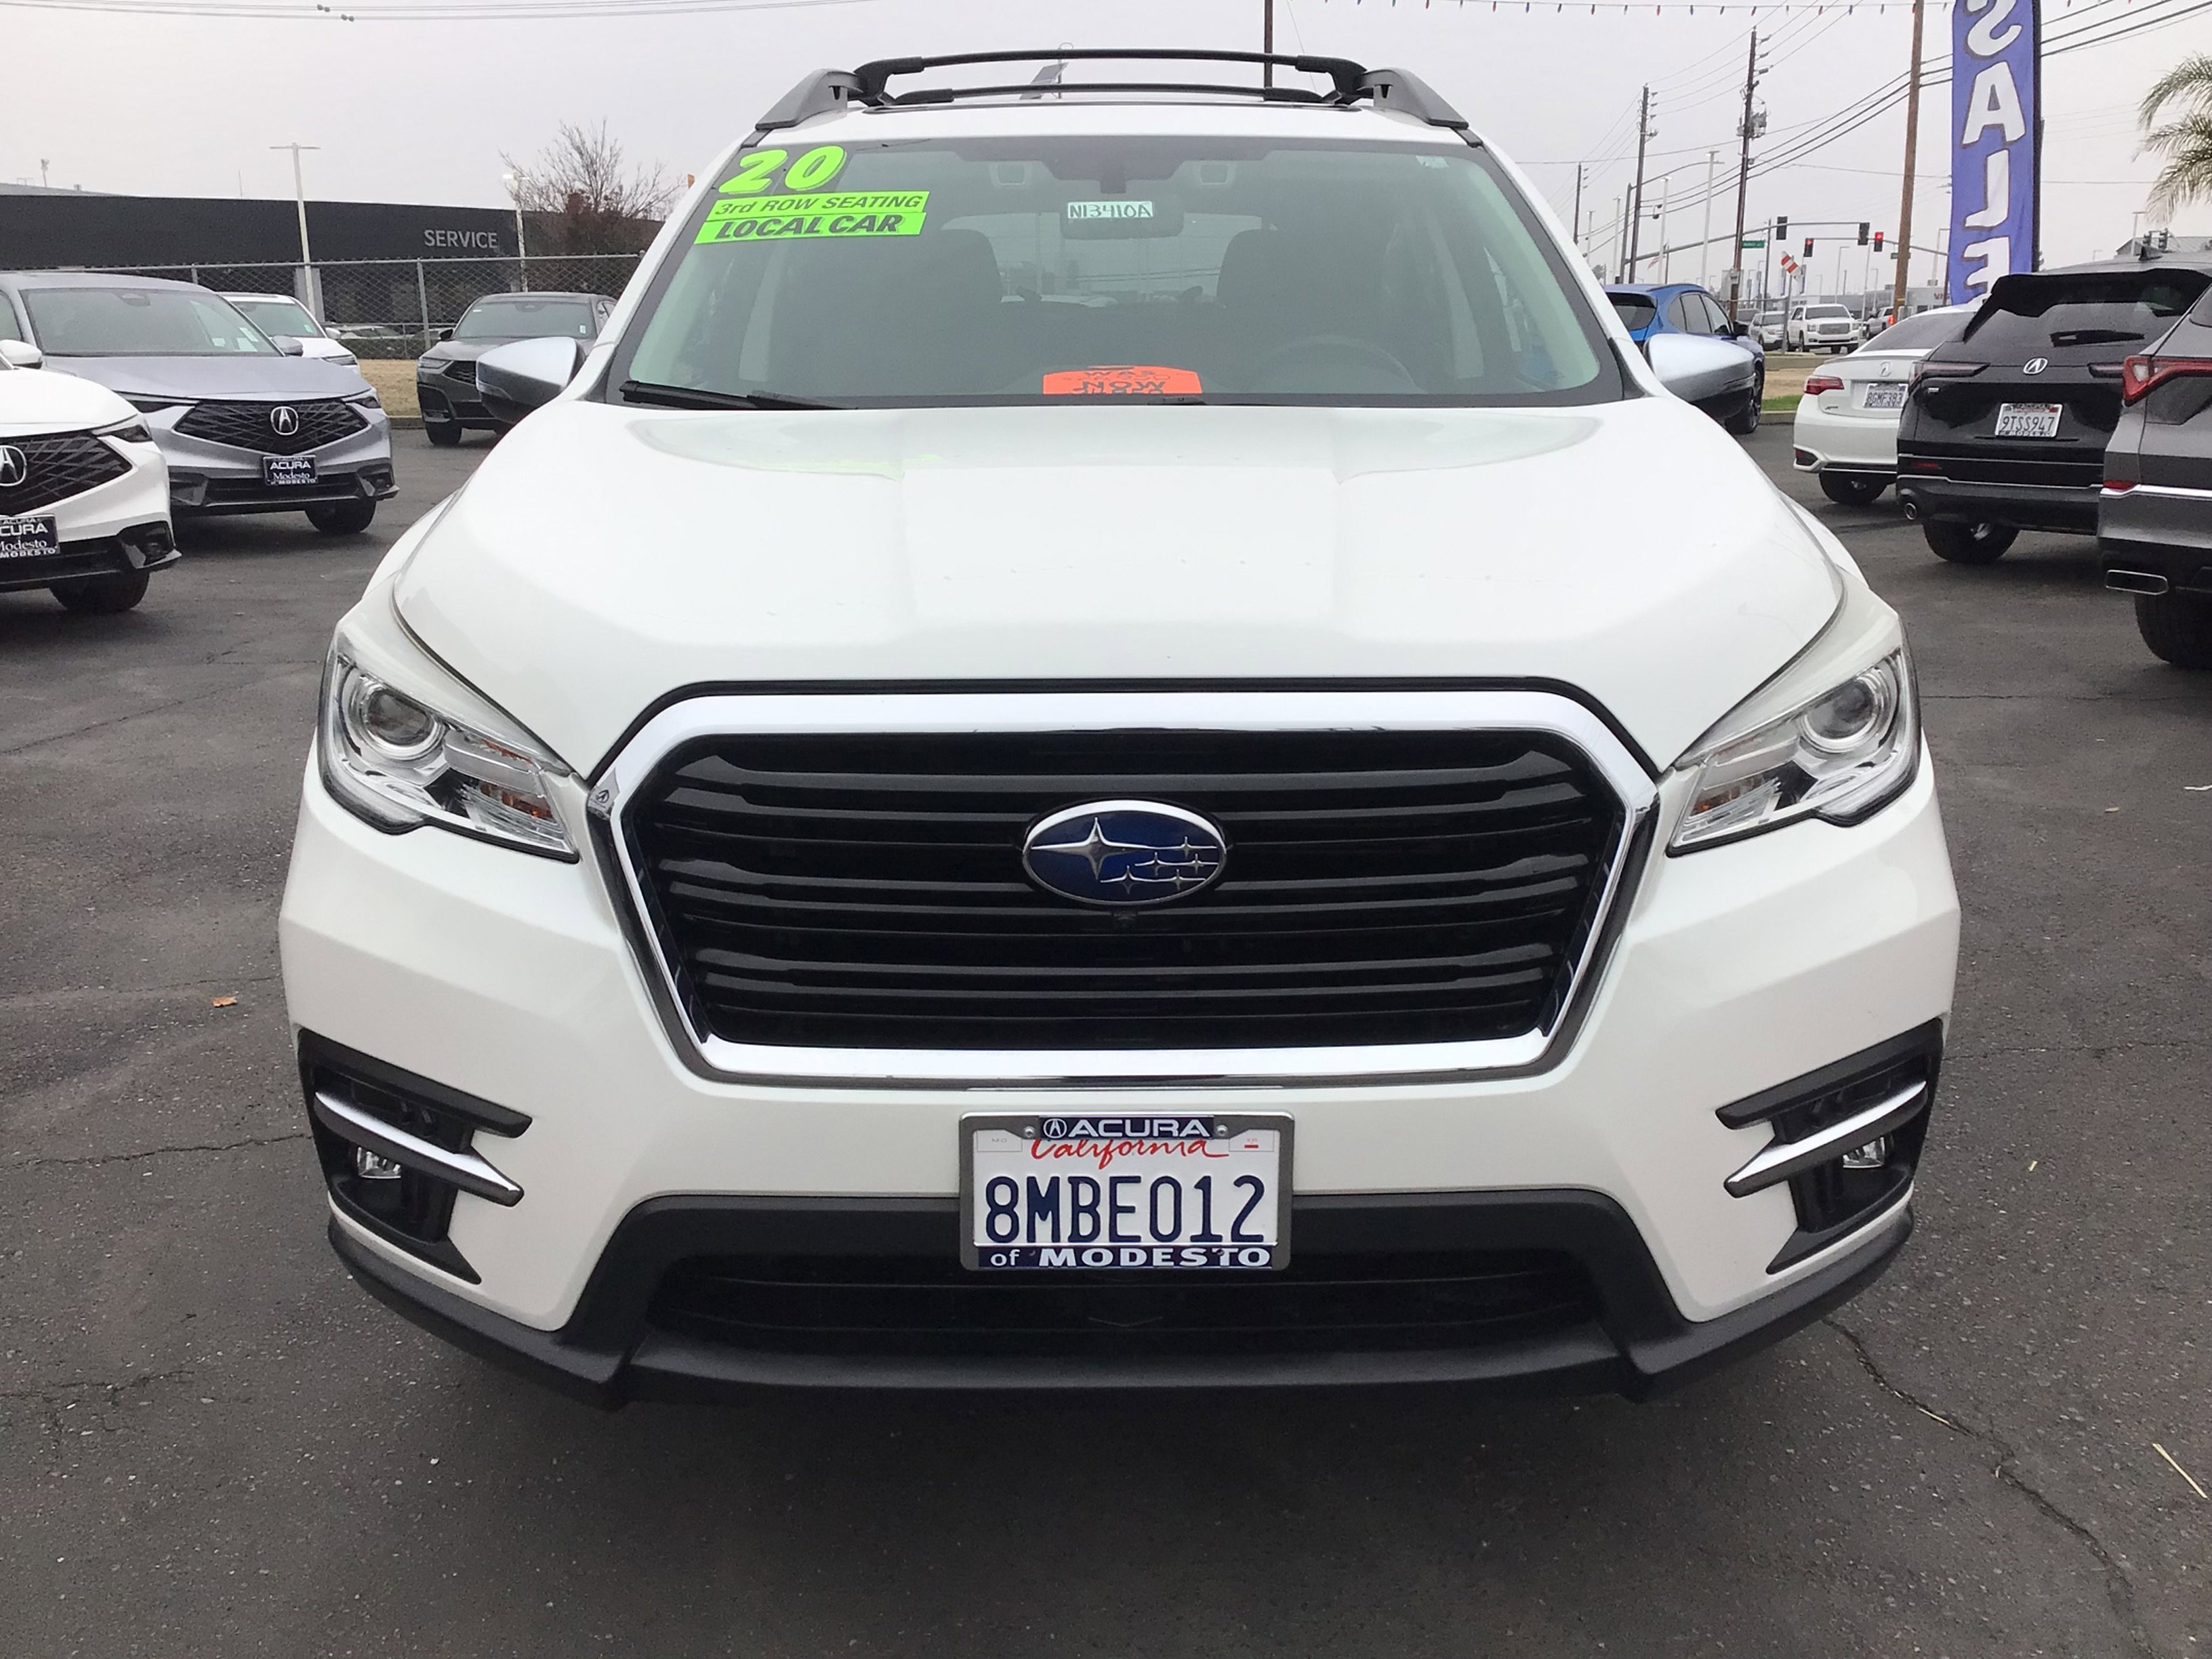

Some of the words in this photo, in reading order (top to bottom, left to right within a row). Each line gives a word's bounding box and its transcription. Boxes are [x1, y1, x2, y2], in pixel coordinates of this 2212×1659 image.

[718, 146, 847, 194] 20
[715, 203, 757, 216] 3rd
[760, 198, 819, 212] ROW
[821, 196, 924, 209] SEATING
[1069, 204, 1151, 218] N13410A
[714, 215, 824, 239] LOCAL
[828, 214, 906, 233] CAR
[424, 229, 498, 249] SERVICE
[1082, 381, 1166, 390] NOW
[2001, 416, 2055, 432] 9TSS947
[270, 461, 312, 470] ACURA
[273, 471, 310, 480] Modesto
[0, 523, 48, 536] CURA
[1067, 1118, 1212, 1139] ACURA
[985, 1174, 1265, 1244] 8MBE012
[990, 1248, 1021, 1267] of
[1039, 1247, 1271, 1267] MODESTO
